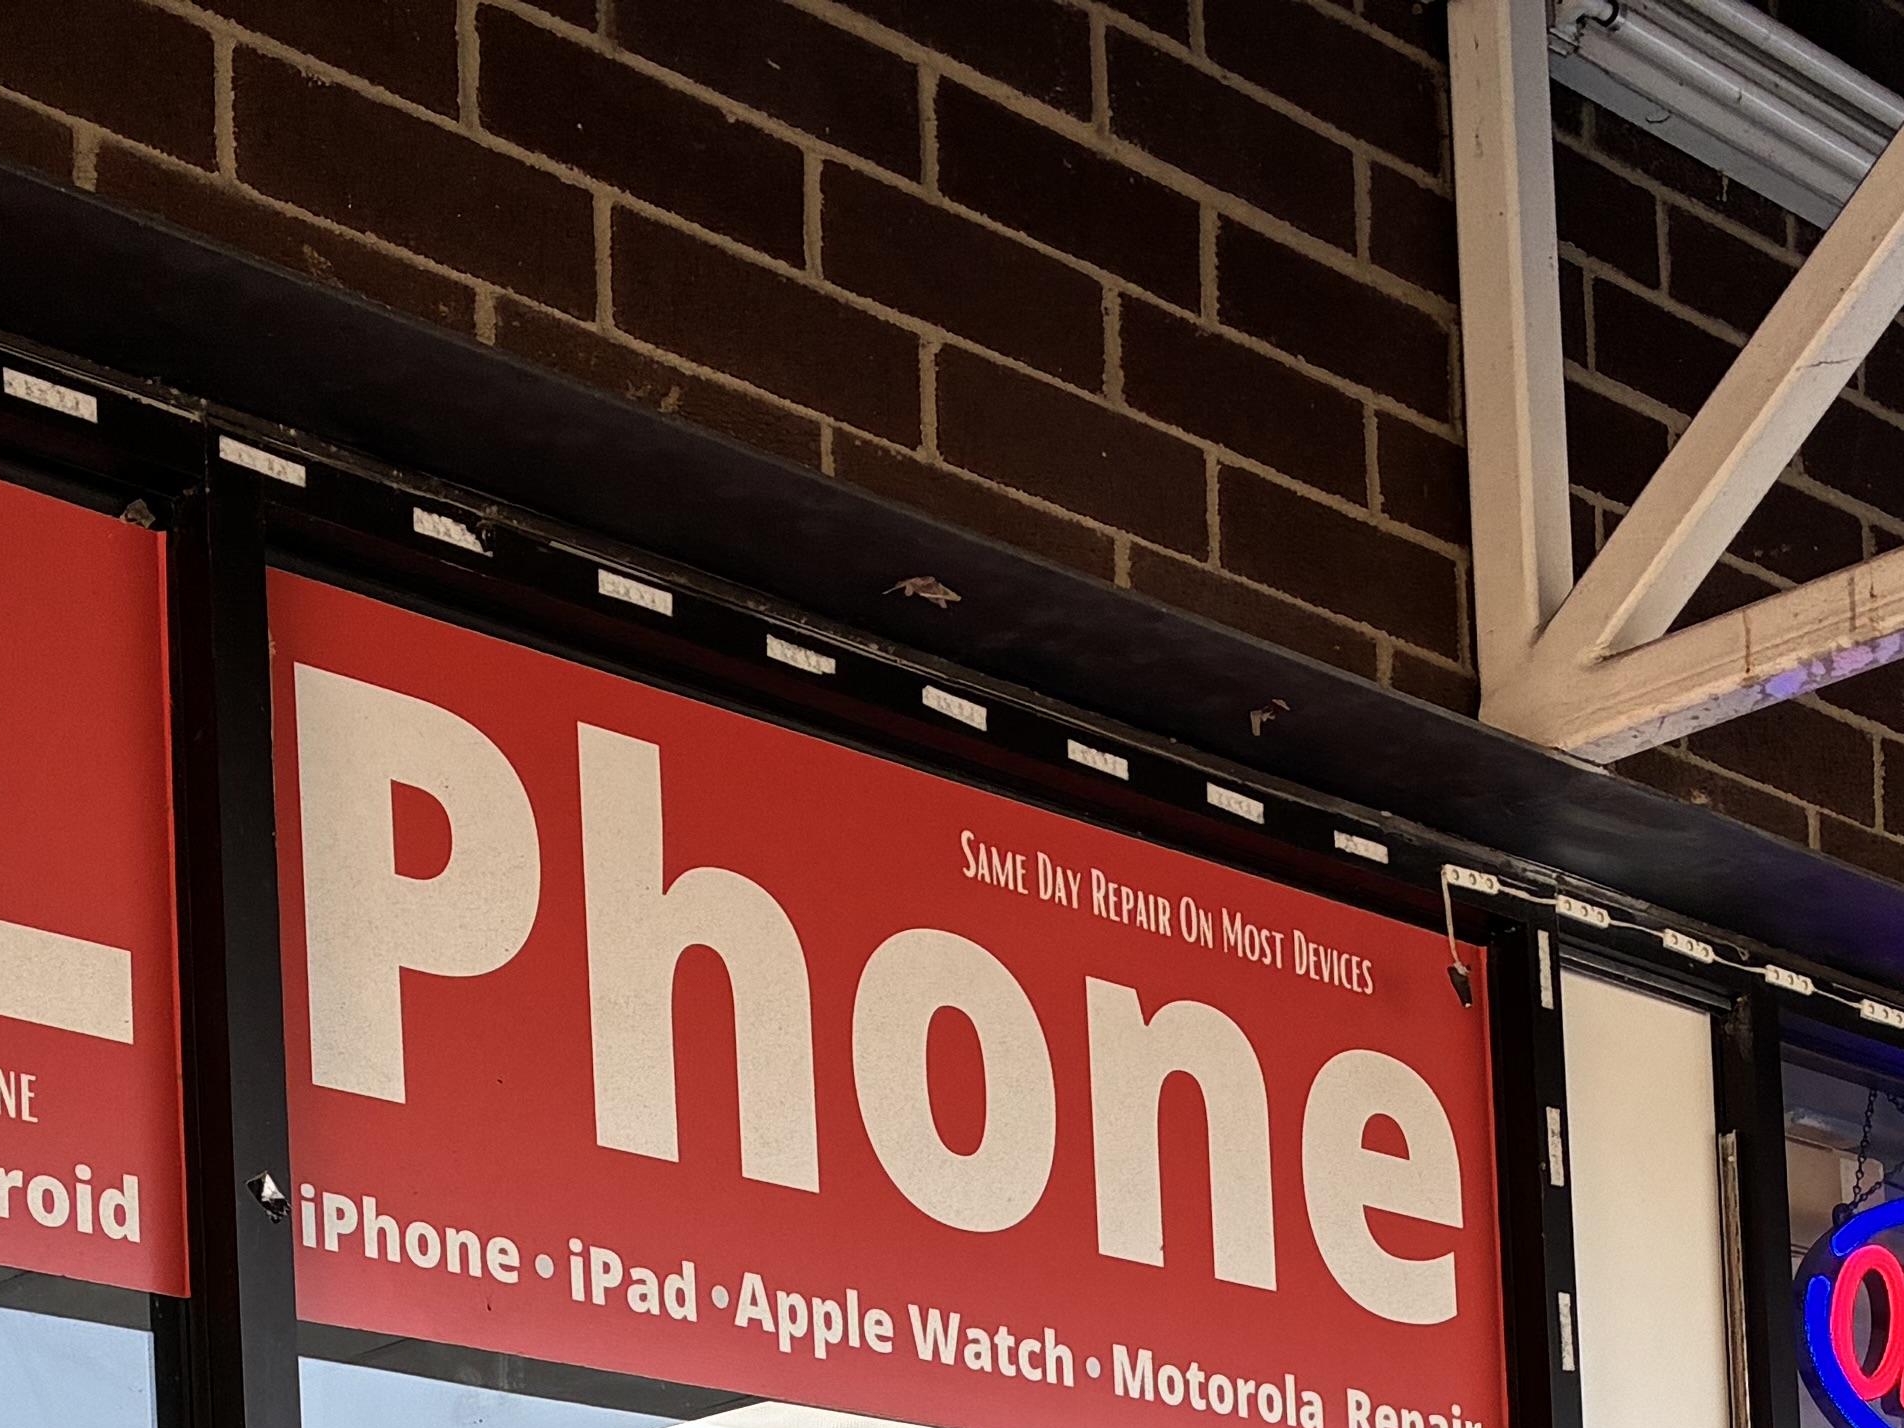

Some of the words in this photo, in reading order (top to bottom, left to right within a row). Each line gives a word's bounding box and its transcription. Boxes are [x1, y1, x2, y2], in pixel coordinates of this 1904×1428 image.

[294, 661, 1465, 1325] Phone
[960, 829, 1028, 894] SAME
[1037, 851, 1081, 910] DAY
[1091, 869, 1172, 938] REPAIR
[1179, 896, 1214, 950] ON
[1221, 906, 1285, 970] MOST
[1293, 928, 1374, 996] DEVICES
[300, 1183, 520, 1284] iPhone
[568, 1237, 697, 1323] iPad
[734, 1272, 894, 1360] Apple
[907, 1304, 1074, 1388] Watch
